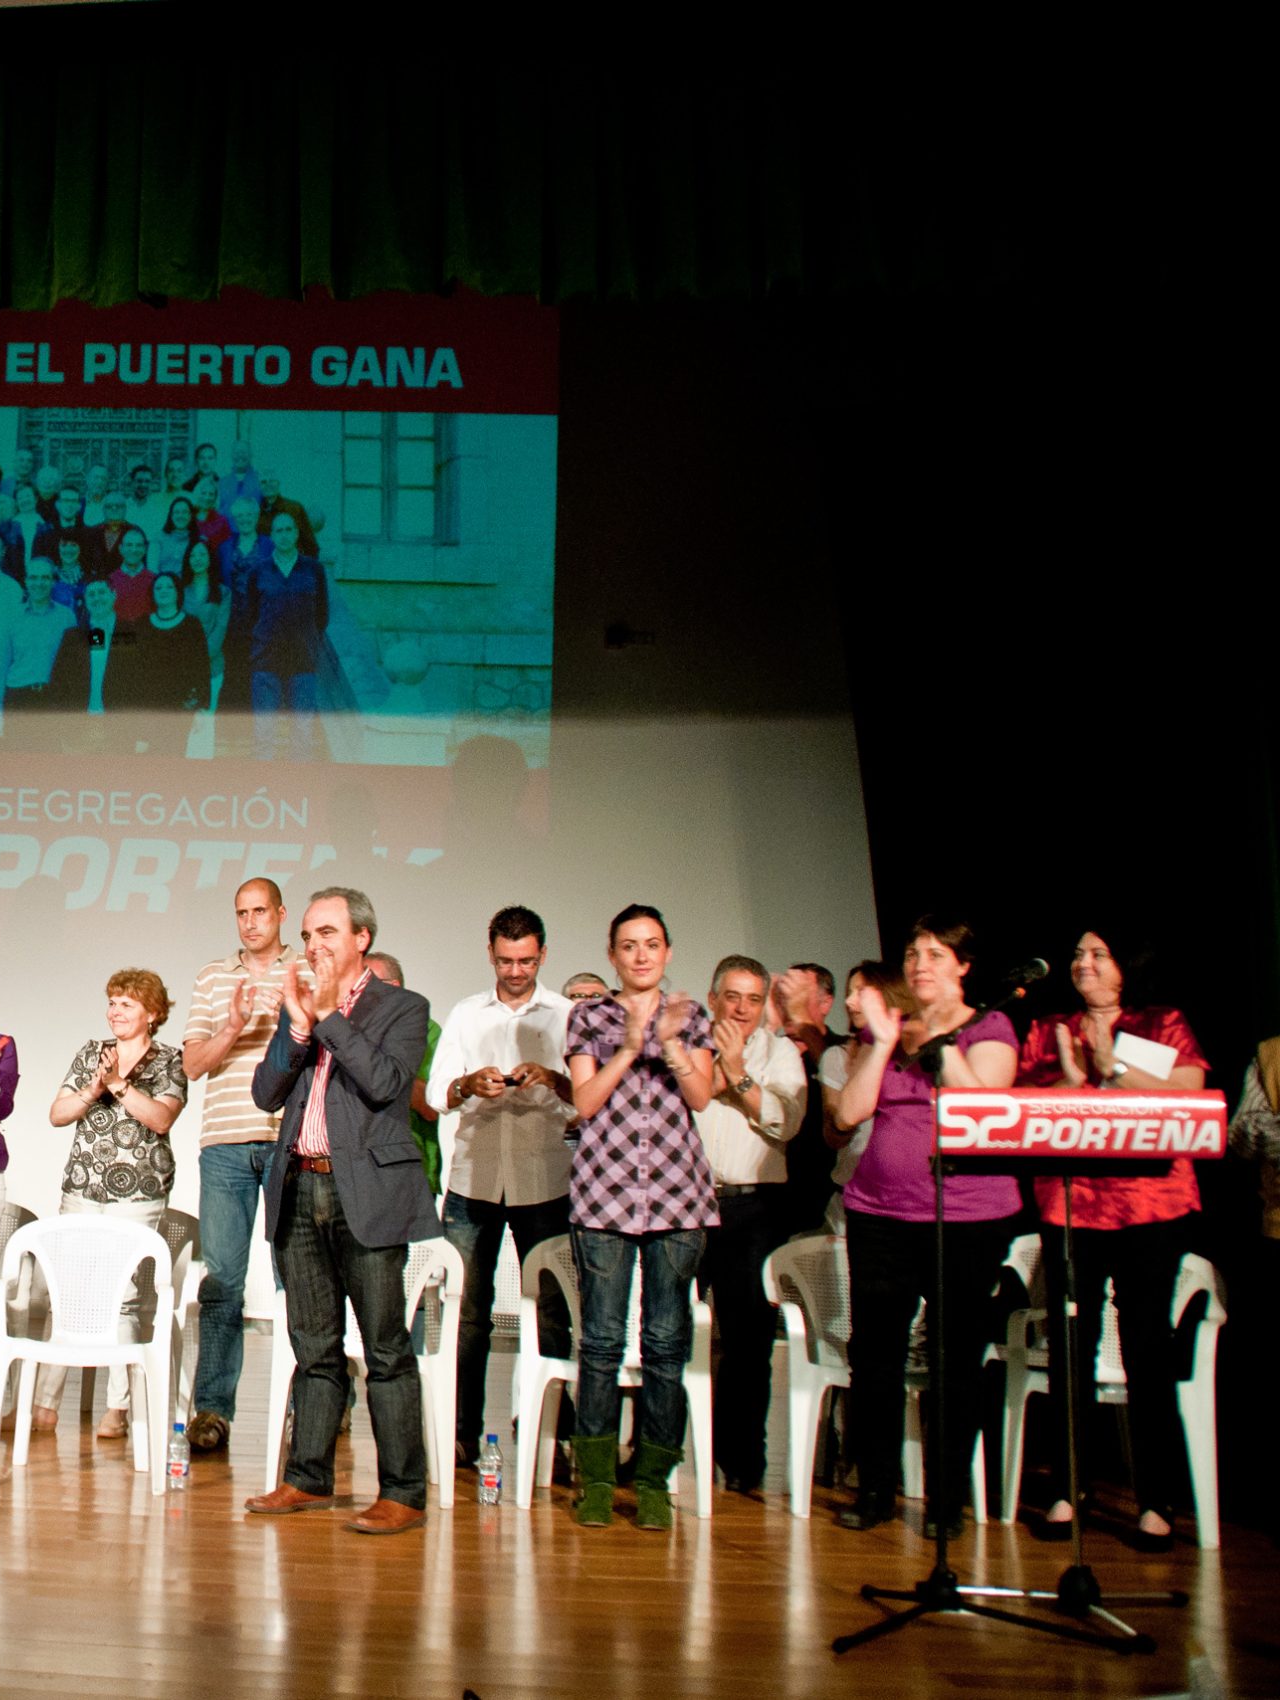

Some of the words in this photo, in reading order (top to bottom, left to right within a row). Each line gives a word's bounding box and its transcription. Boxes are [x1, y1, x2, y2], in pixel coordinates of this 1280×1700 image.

[5, 343, 65, 383] EL
[82, 343, 292, 385] PUERTO
[310, 345, 464, 388] GANA
[1022, 1110, 1221, 1152] PORTEÑA
